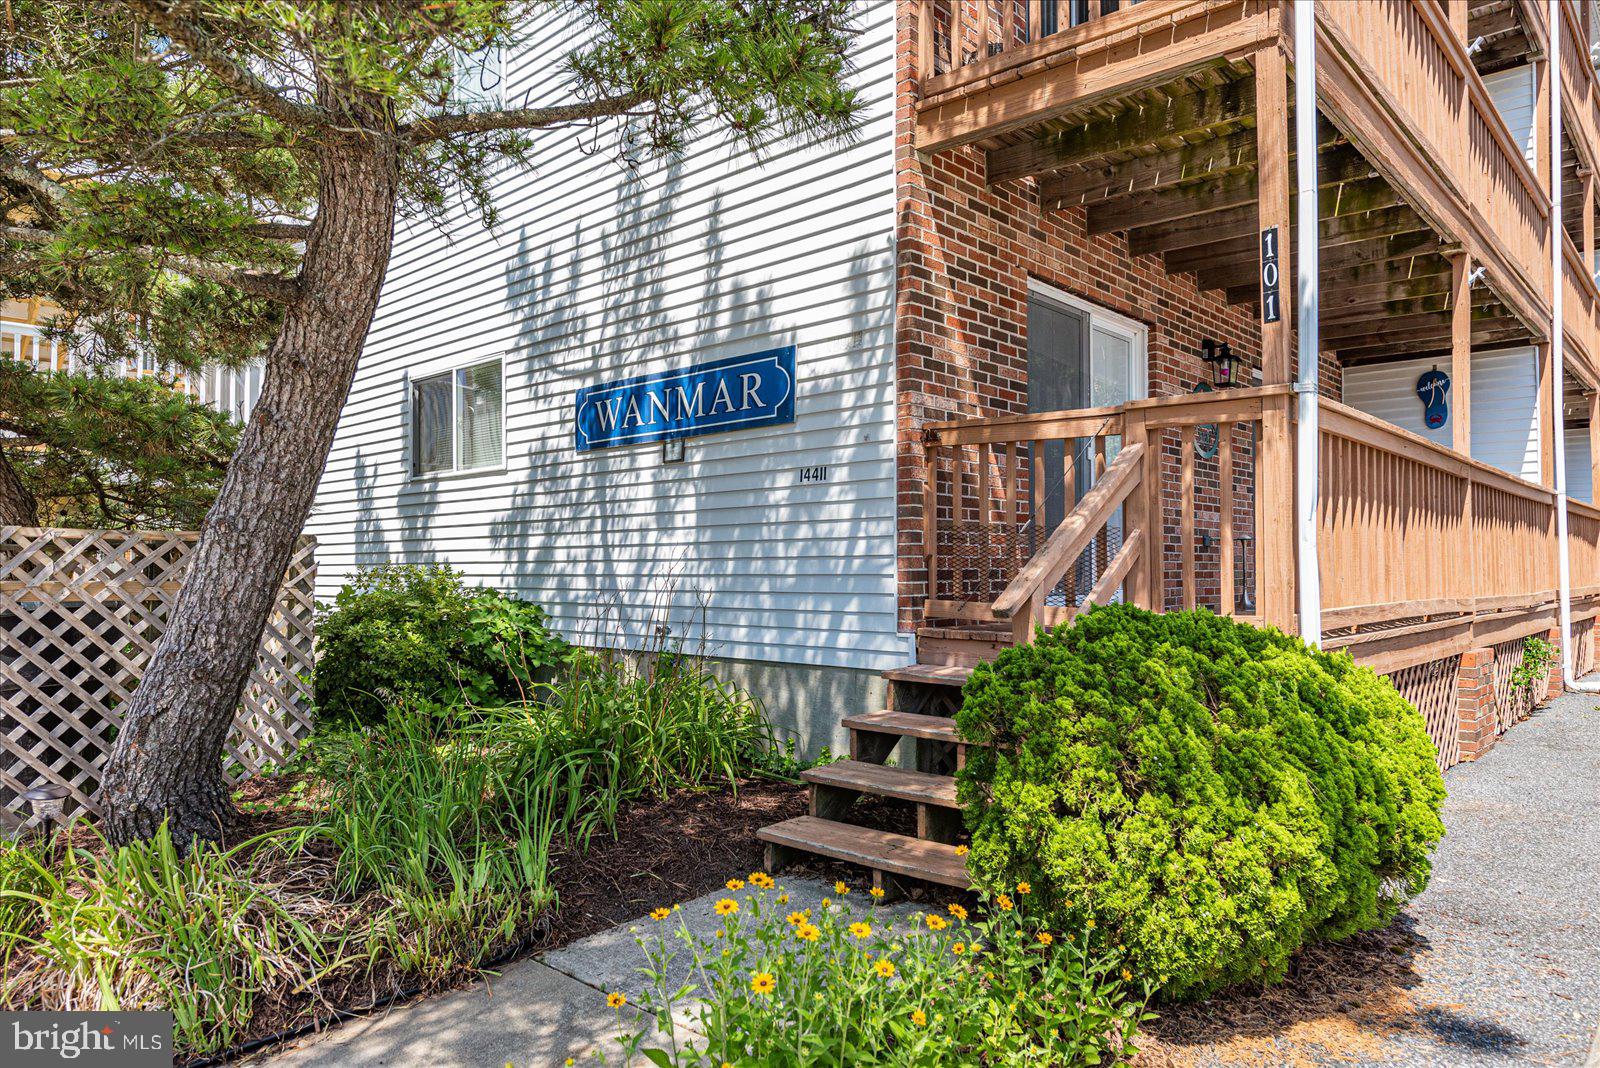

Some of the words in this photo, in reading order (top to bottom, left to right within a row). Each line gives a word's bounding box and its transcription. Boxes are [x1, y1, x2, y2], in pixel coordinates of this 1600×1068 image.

[1264, 232, 1278, 320] 101
[595, 372, 766, 432] WANMAR
[800, 466, 827, 482] 14411
